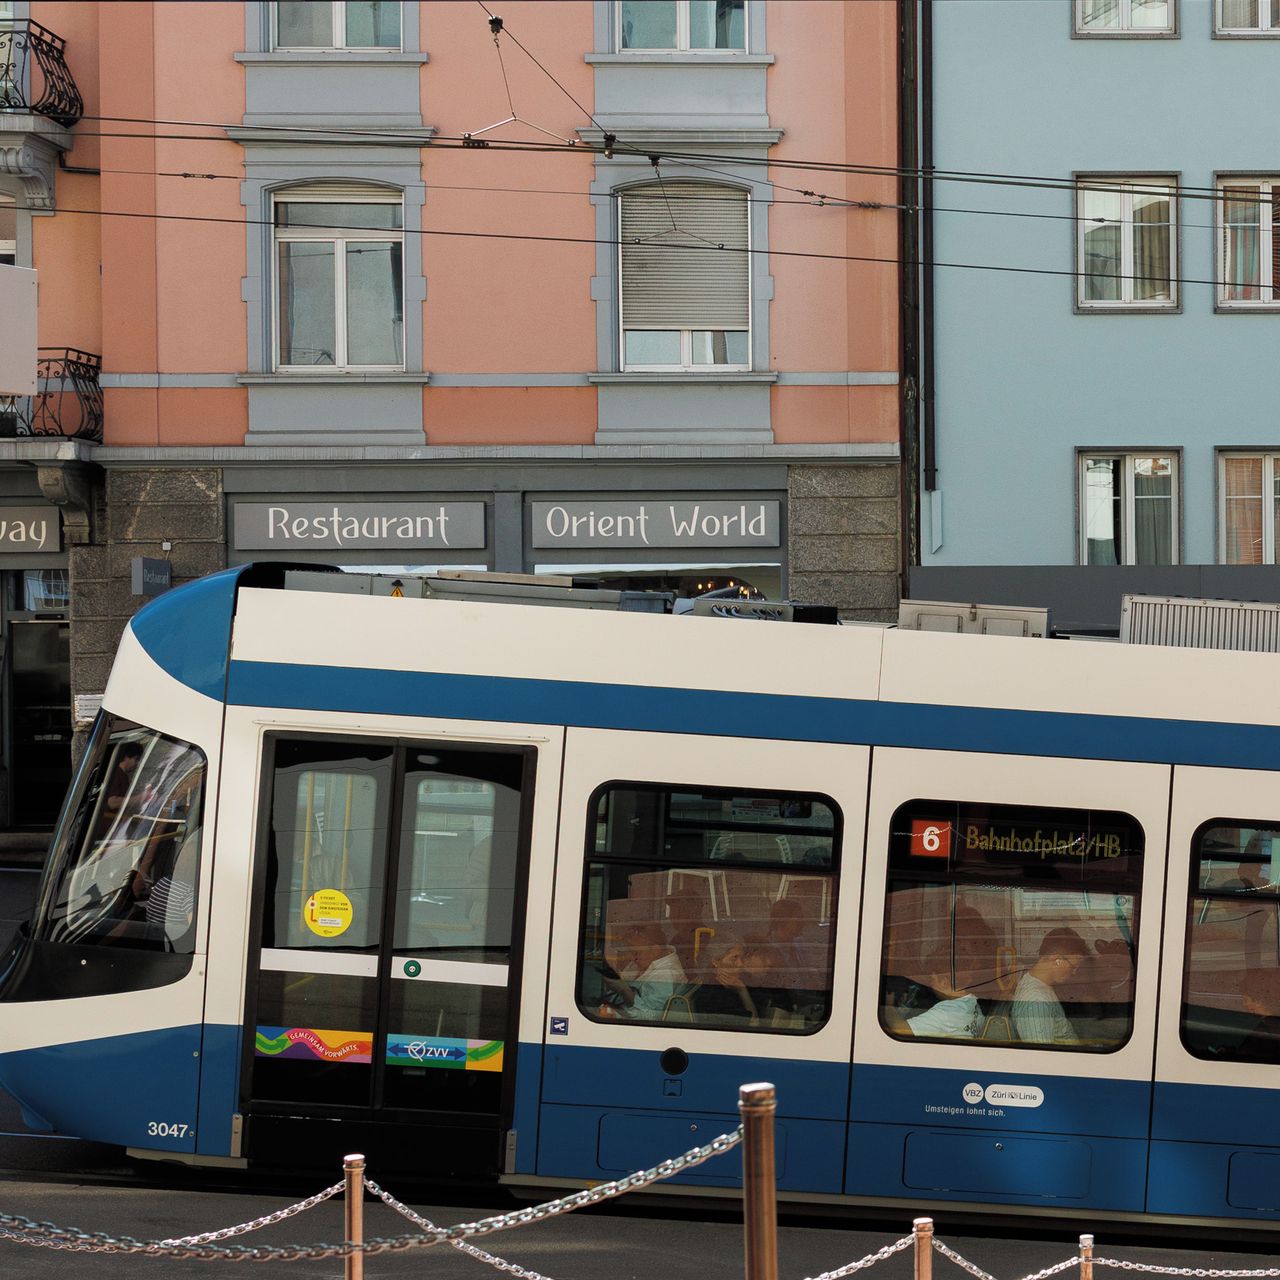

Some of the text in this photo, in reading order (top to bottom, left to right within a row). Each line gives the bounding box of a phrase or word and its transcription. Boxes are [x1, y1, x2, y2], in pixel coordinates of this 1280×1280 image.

[267, 506, 450, 547] Restaurant
[545, 503, 766, 545] Orient World
[922, 826, 940, 852] 6
[966, 825, 1121, 860] Bahnhofplatz/HB
[290, 1031, 324, 1053] GEMEINSAM
[426, 1047, 449, 1058] ZVV
[964, 1089, 982, 1098] VBZ
[991, 1090, 1037, 1101] Züri Linie
[925, 1105, 1007, 1117] Umsteigen lohnt sich.
[148, 1122, 188, 1138] 3047
